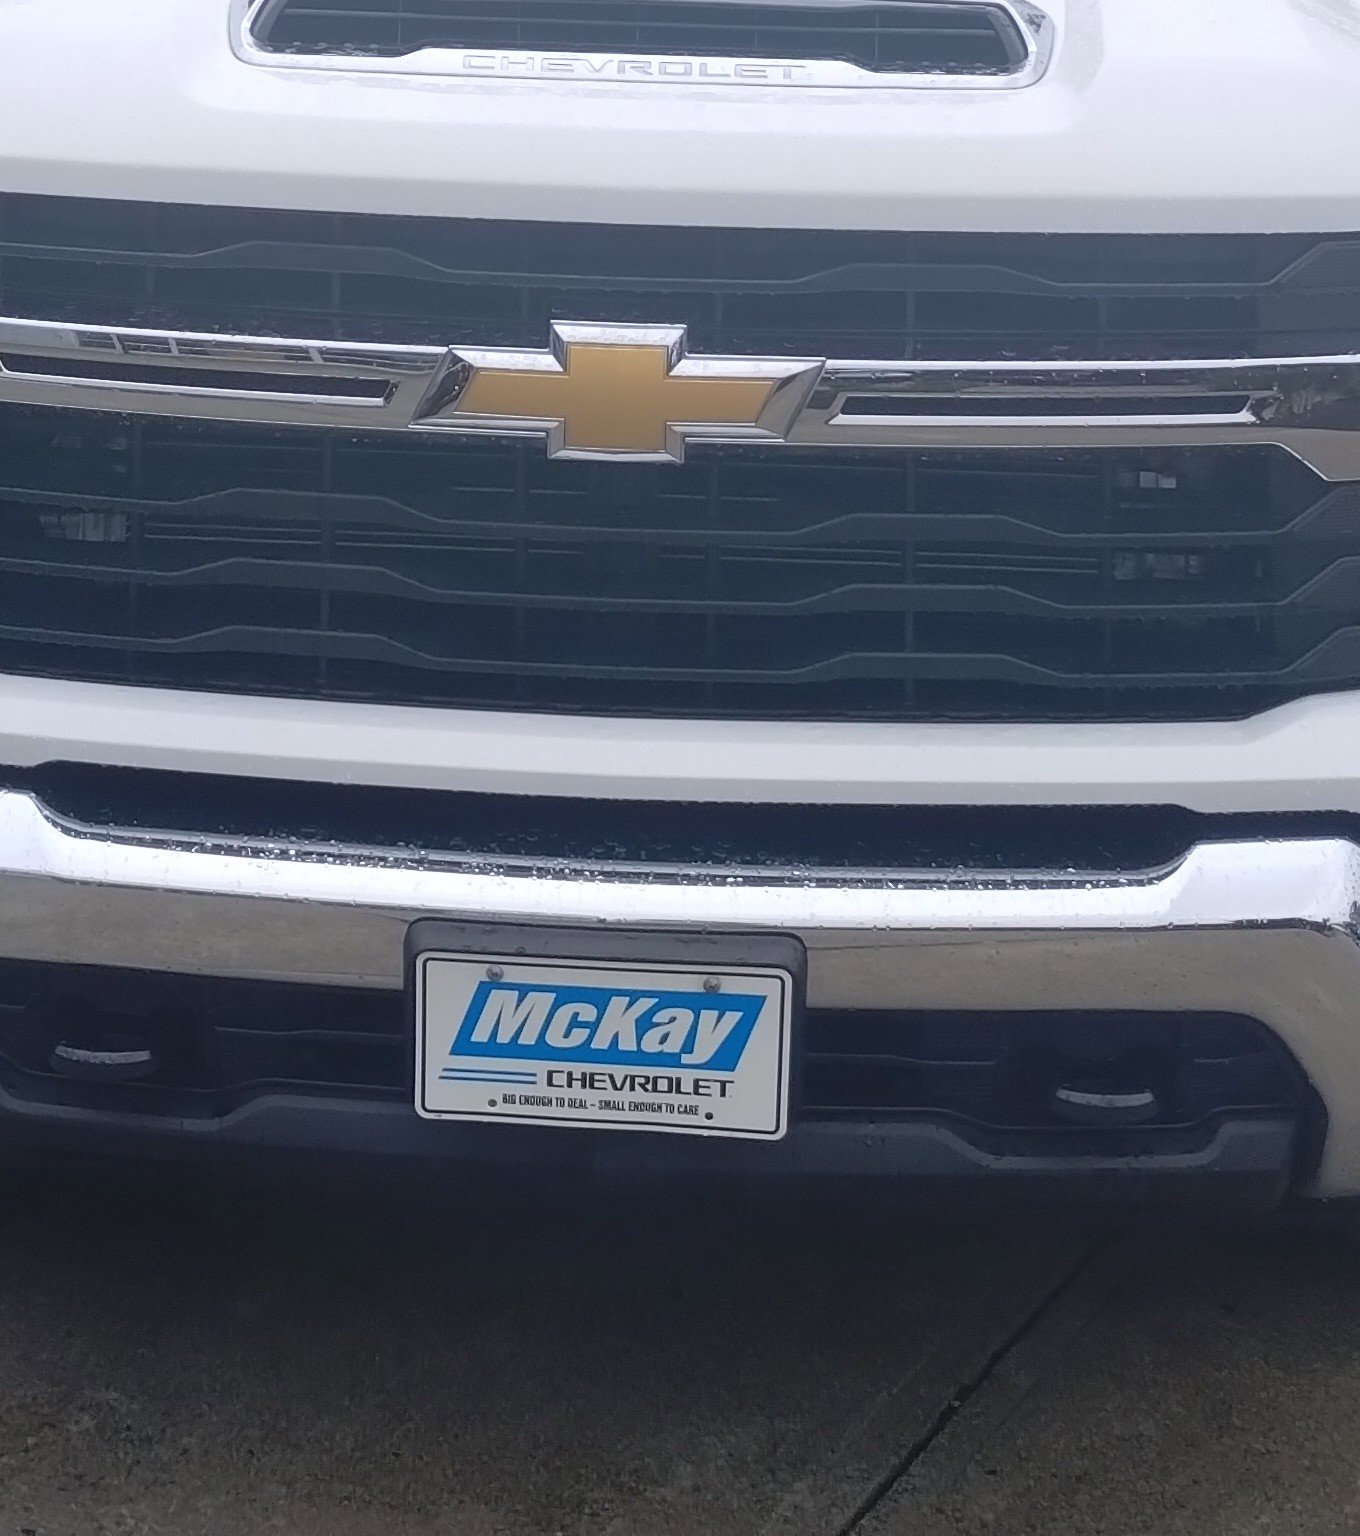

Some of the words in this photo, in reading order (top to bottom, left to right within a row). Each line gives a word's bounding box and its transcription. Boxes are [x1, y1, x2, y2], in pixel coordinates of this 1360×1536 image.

[461, 54, 807, 81] CHEVROLET
[469, 988, 744, 1066] McKay
[546, 1069, 735, 1099] CHEVROLET
[502, 1093, 517, 1106] BIG
[519, 1094, 553, 1108] ENOUGH
[554, 1096, 566, 1108] TO
[568, 1096, 589, 1110] DEAL
[598, 1100, 626, 1112] SMALL
[628, 1101, 663, 1114] ENOUGH
[664, 1102, 676, 1114] TO
[677, 1104, 700, 1116] CARE
